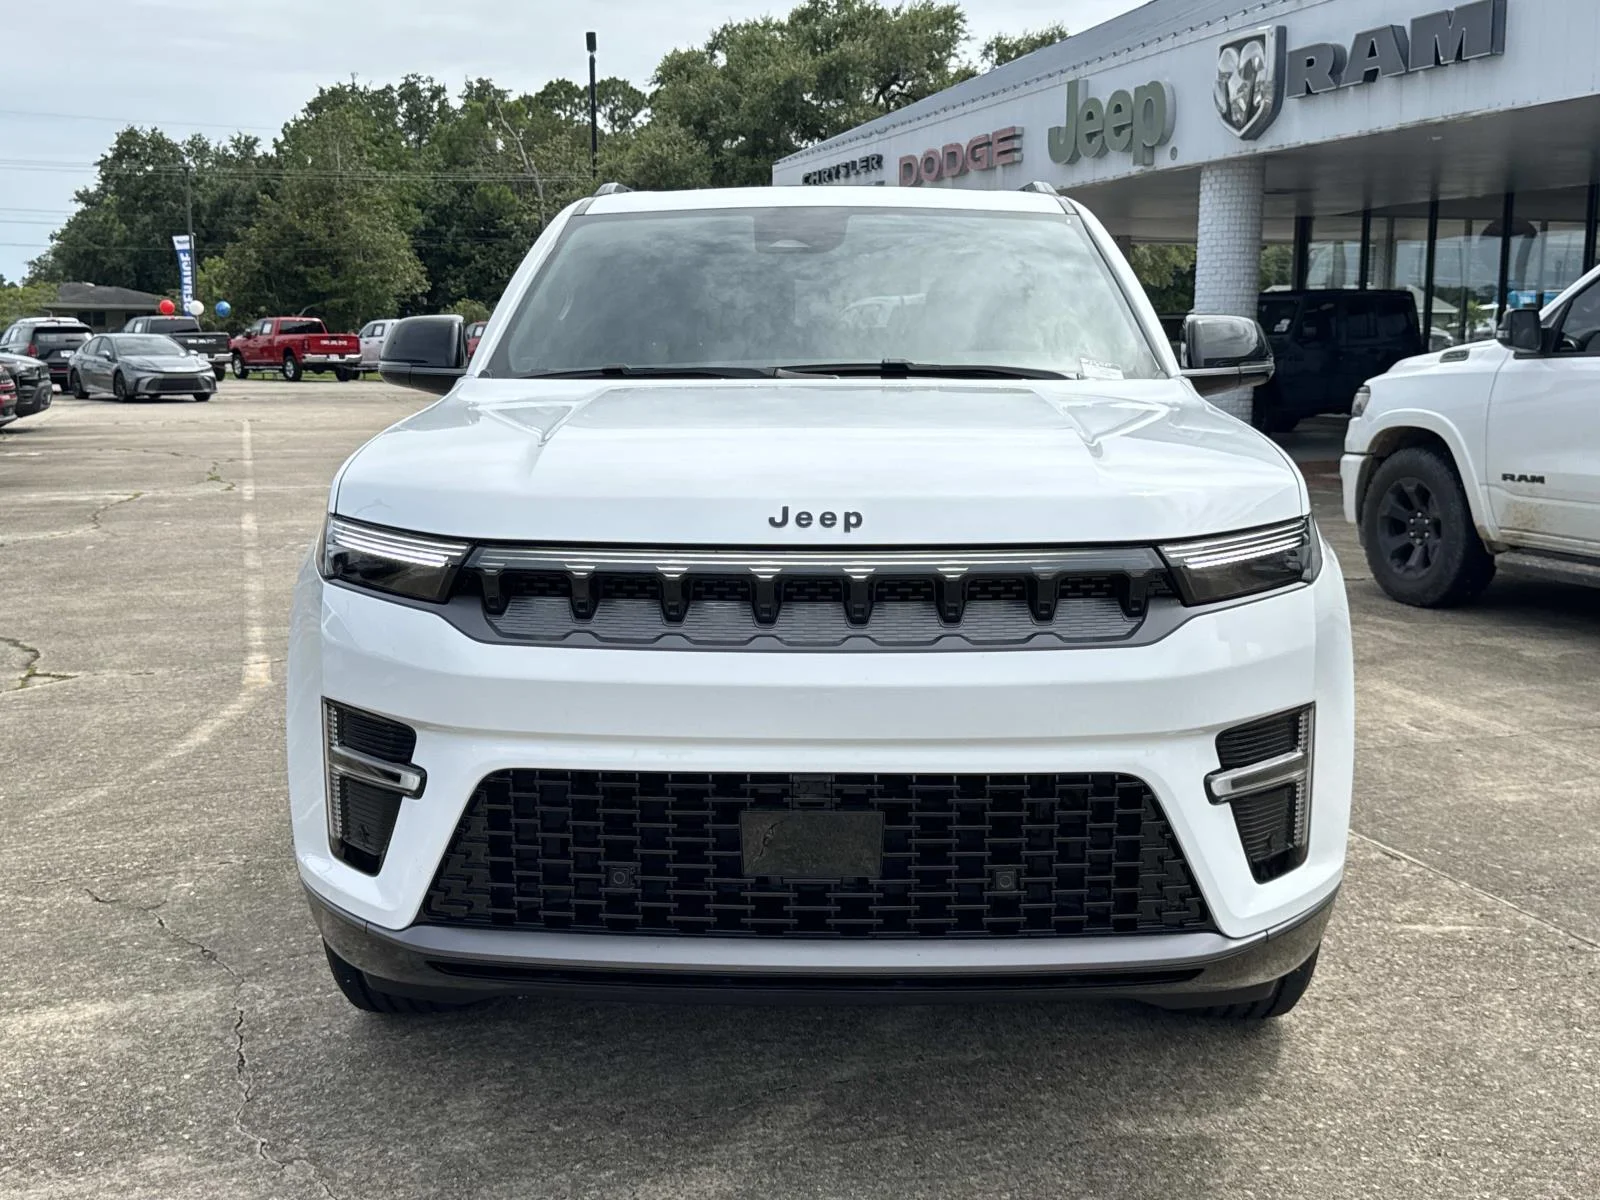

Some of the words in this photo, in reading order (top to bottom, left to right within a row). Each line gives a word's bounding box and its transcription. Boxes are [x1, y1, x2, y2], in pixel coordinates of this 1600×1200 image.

[1287, 0, 1505, 98] RAM
[1048, 79, 1174, 166] Jeep
[802, 153, 883, 186] CHRYSLER
[899, 127, 1022, 187] DODGE
[1501, 473, 1545, 484] RAM
[768, 505, 863, 533] Jeep
